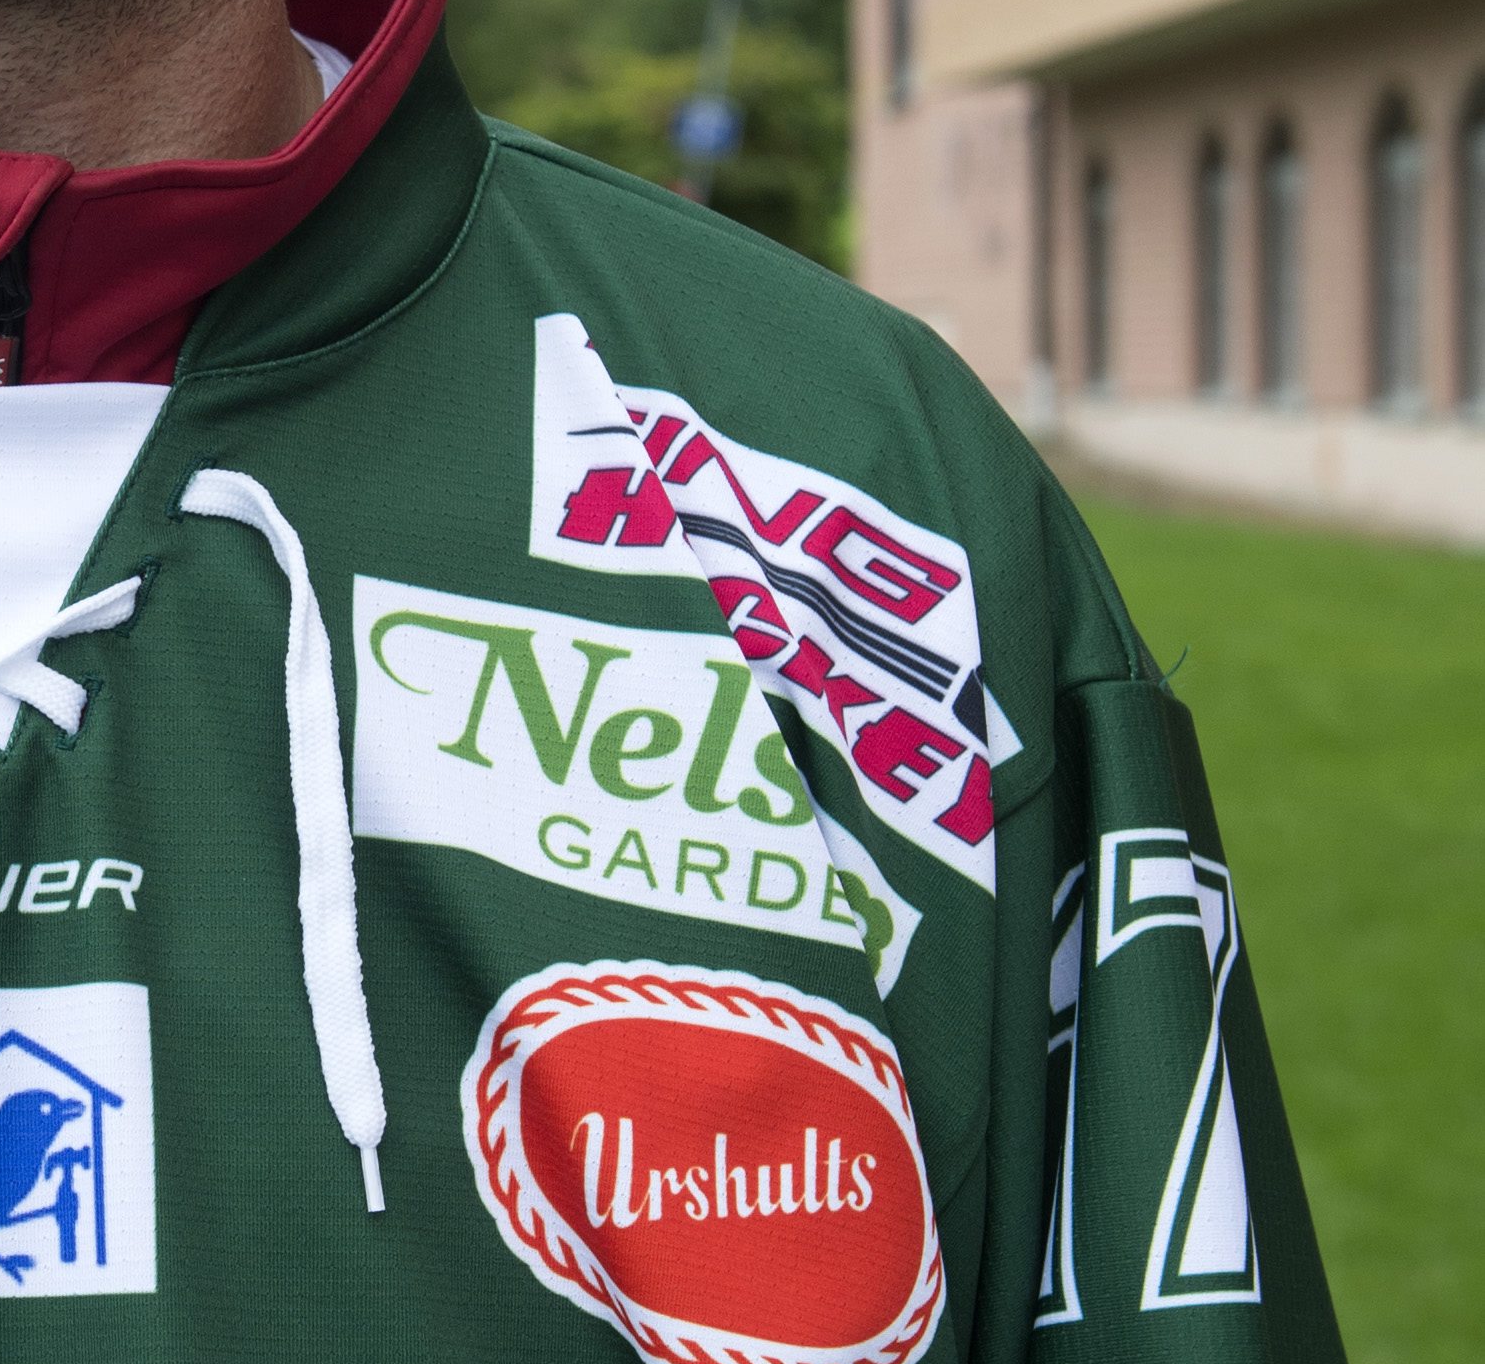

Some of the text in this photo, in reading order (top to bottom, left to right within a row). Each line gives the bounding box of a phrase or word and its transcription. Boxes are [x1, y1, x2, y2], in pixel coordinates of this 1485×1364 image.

[369, 609, 817, 827] Nels
[537, 814, 858, 928] GARDE
[570, 1111, 877, 1230] Urshults
